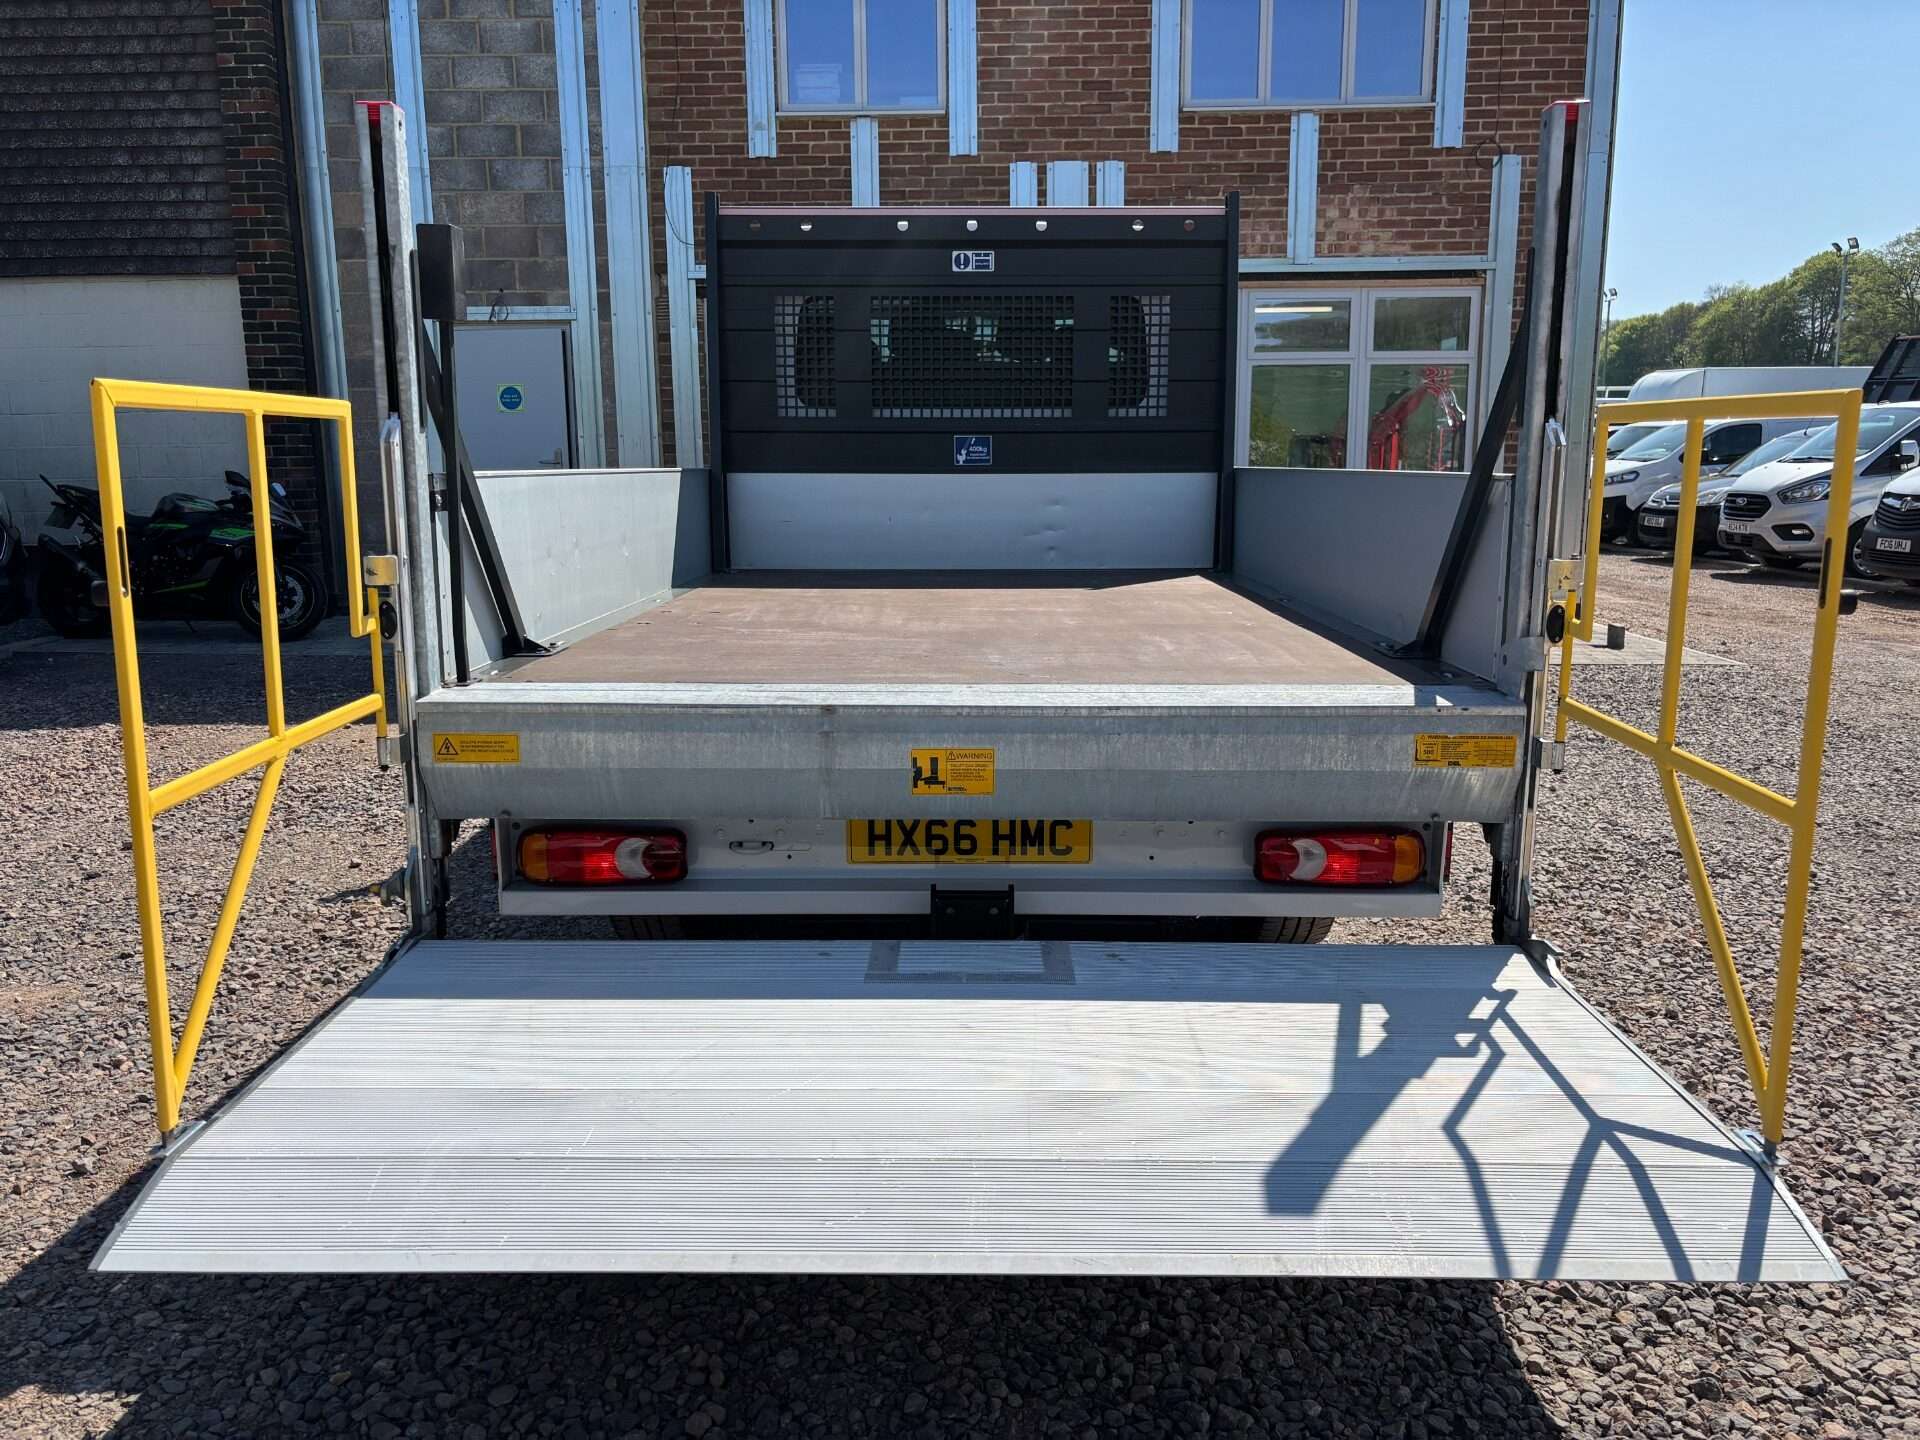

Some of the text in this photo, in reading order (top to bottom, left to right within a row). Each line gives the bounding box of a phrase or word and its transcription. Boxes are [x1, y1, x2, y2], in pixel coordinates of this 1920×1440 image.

[957, 752, 993, 760] WARNING
[867, 819, 1073, 856] HX66 HMC
